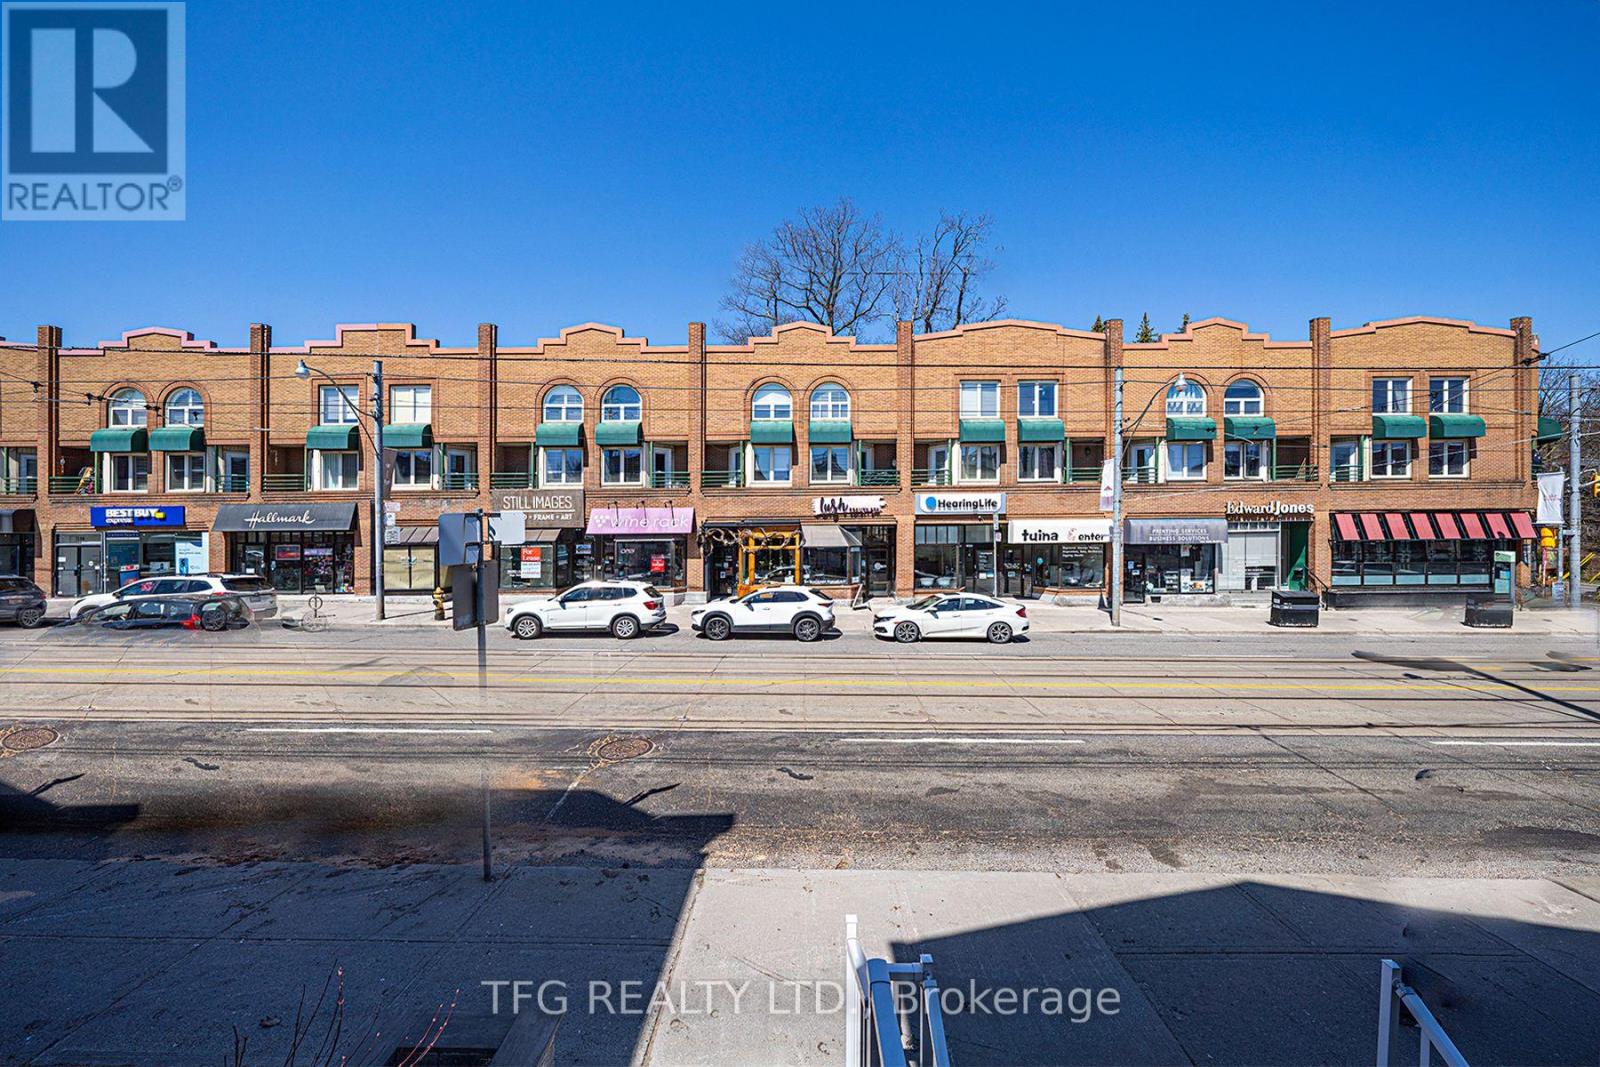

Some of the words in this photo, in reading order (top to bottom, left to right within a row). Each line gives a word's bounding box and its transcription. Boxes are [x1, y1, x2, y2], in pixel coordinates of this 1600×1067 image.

[502, 496, 531, 510] STILL
[532, 496, 573, 509] IMAGES
[937, 498, 998, 510] HearingLife
[1226, 500, 1274, 514] Edward
[1273, 500, 1315, 515] Jones
[105, 508, 133, 518] BEST
[134, 508, 160, 518] BUY
[243, 509, 316, 530] Hallmark
[610, 517, 649, 528] wine
[654, 513, 689, 528] rack
[1021, 528, 1059, 542] tuina
